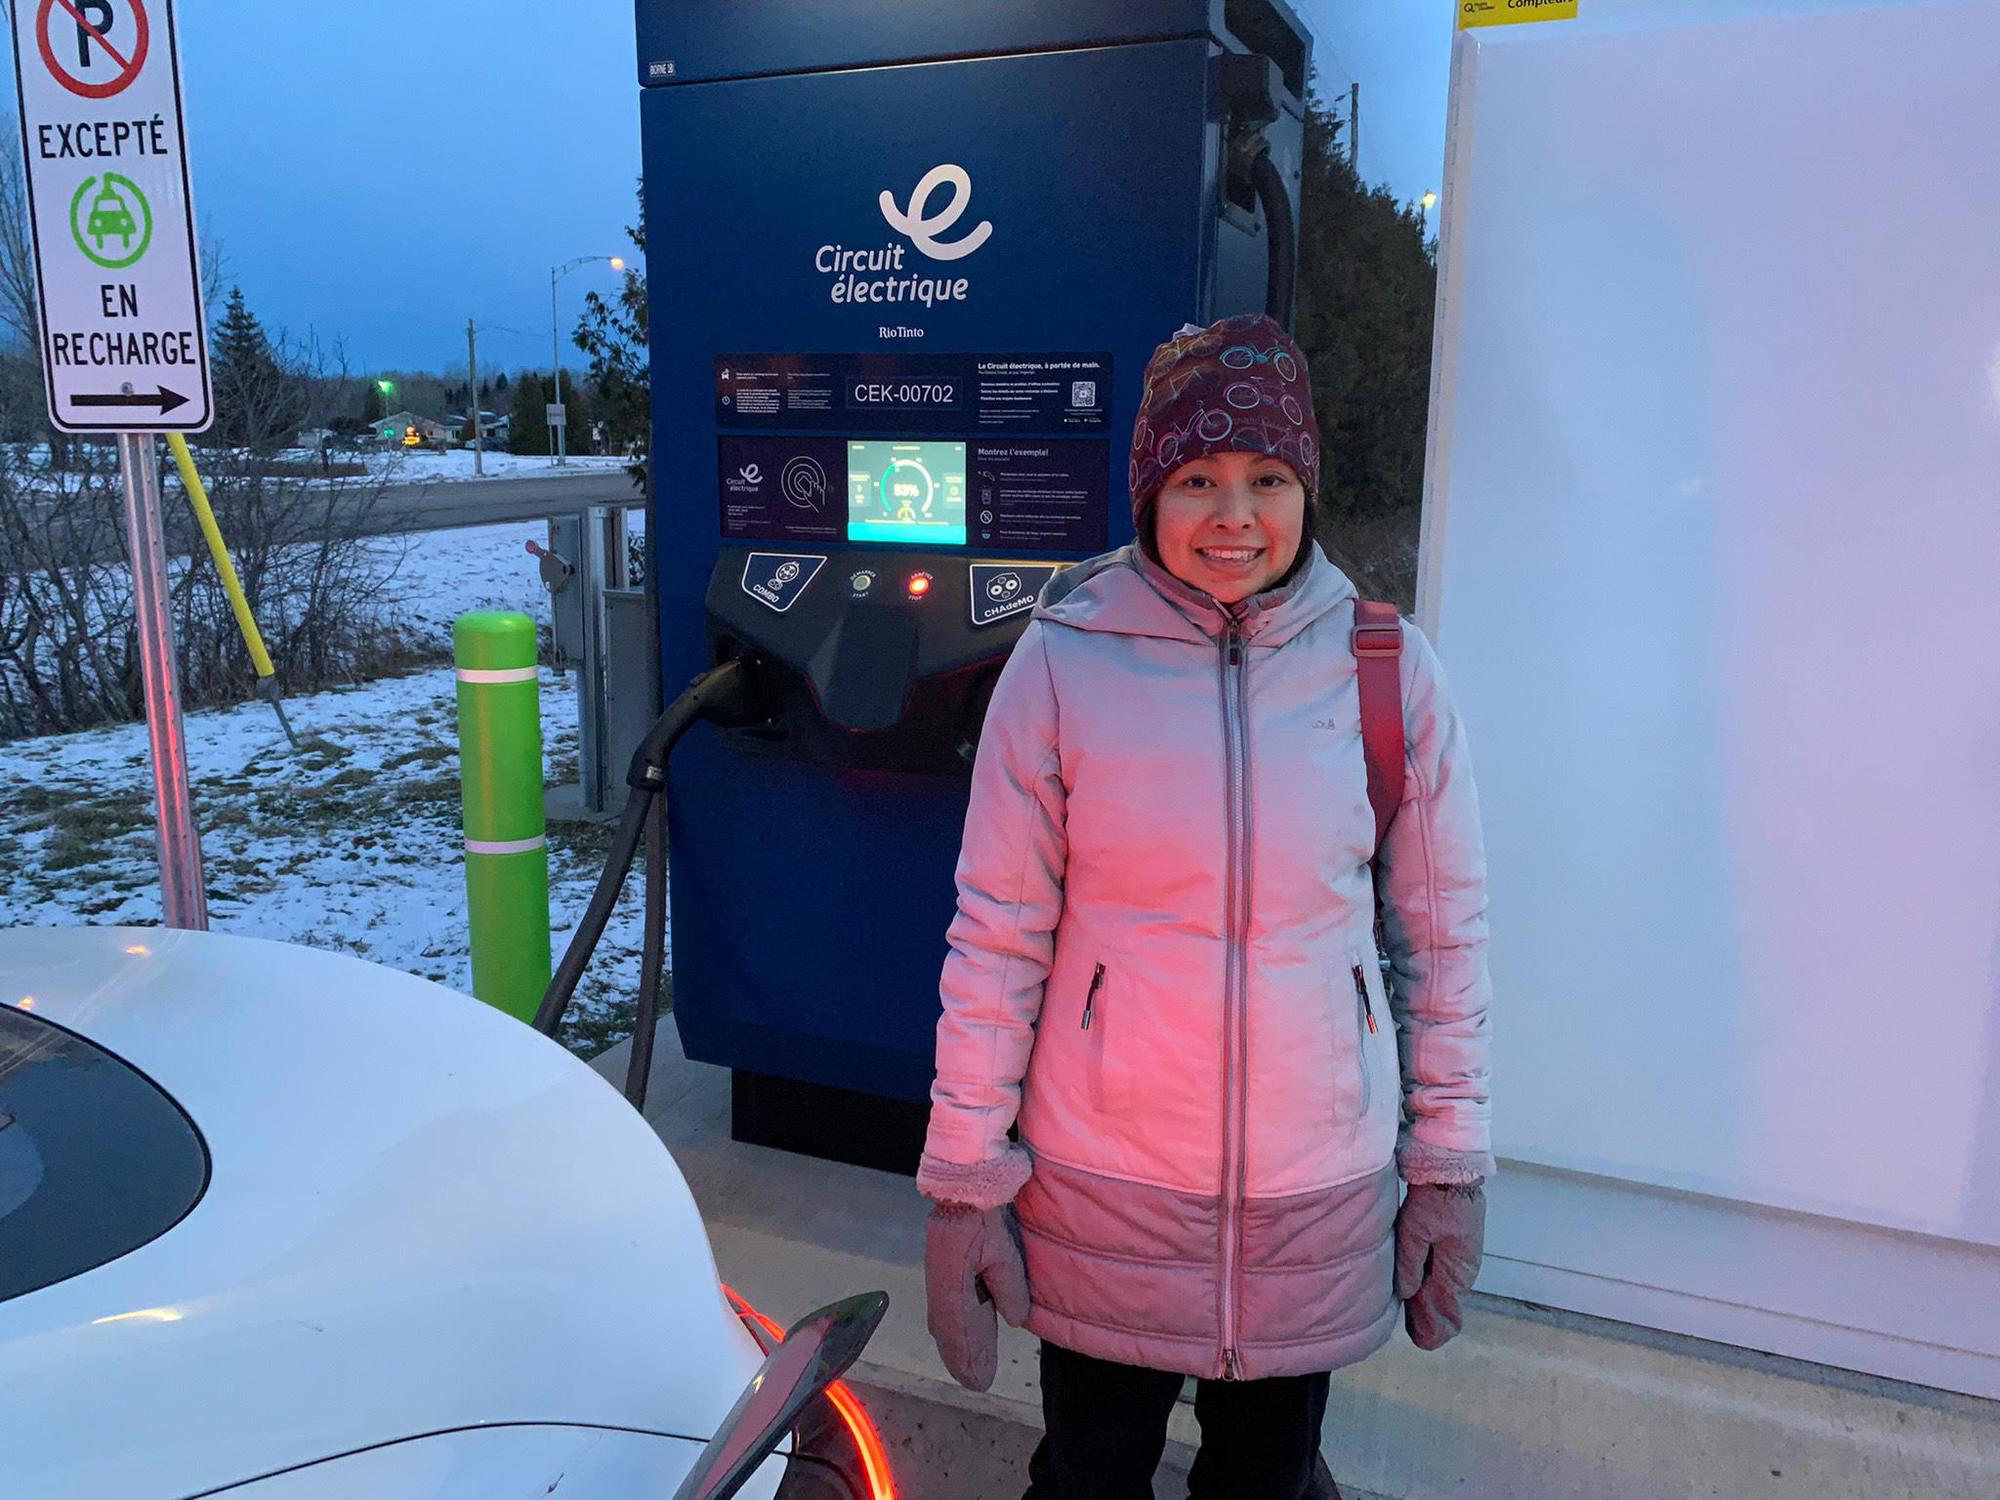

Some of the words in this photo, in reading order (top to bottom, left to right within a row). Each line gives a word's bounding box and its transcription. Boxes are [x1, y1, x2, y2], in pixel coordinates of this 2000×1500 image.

[1507, 0, 1573, 9] Compte
[38, 114, 168, 159] EXCEPTÉ
[815, 242, 905, 273] Circuit
[100, 284, 138, 318] EN
[831, 273, 969, 308] électrique
[53, 331, 196, 366] RECHARGE
[987, 362, 1009, 370] Circuit
[1009, 362, 1044, 371] électrique,
[1049, 362, 1072, 371] portée
[1072, 361, 1081, 369] de
[1081, 361, 1101, 369] main.
[854, 384, 954, 403] CEK-00702
[978, 448, 1008, 456] Montrez
[753, 584, 780, 603] COMBO
[984, 595, 1034, 618] CHAdeMO
